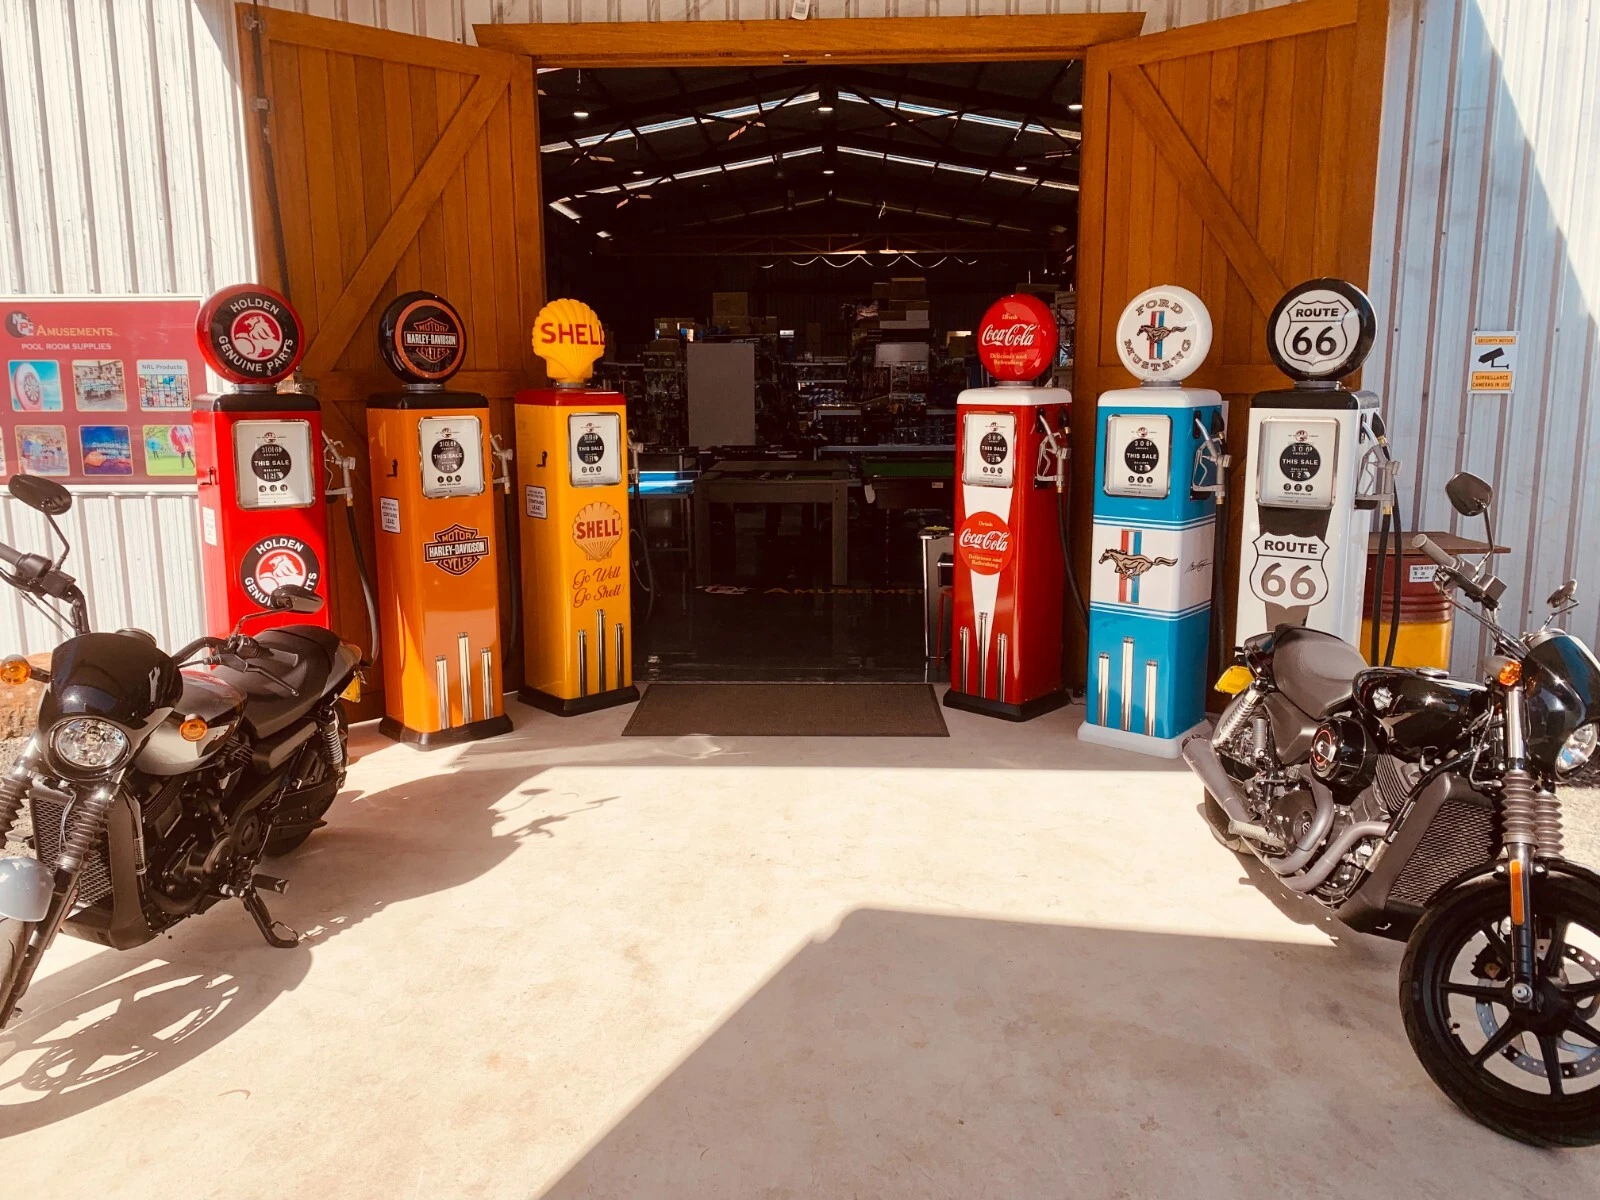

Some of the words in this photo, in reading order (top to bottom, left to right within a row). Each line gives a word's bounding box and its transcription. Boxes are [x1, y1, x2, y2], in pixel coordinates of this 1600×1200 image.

[230, 298, 280, 315] HOLDEN
[1135, 298, 1184, 317] FORD
[1295, 308, 1340, 318] ROUTE
[1002, 312, 1018, 320] Drink
[36, 325, 113, 337] AMUSEMENTS
[418, 321, 446, 332] MOTOR
[540, 322, 606, 346] SHELL
[981, 323, 1037, 346] Coca-Cola
[406, 333, 456, 345] HARLEY-DAVIDSON
[1292, 326, 1337, 356] 66
[219, 335, 263, 372] GENUINE
[266, 338, 293, 370] PARTS
[420, 347, 446, 360] CYCLES
[1124, 338, 1192, 372] MUSTANG
[441, 529, 471, 542] MOTOR
[576, 518, 620, 540] SHELL
[255, 537, 304, 555] HOLDEN
[959, 528, 1010, 552] Coca-Cola
[1264, 540, 1318, 554] ROUTE
[429, 541, 485, 558] HARLEY-DAVIDSON
[443, 556, 473, 571] CYCLES
[971, 560, 999, 569] Refreshing
[572, 569, 590, 590] Go
[592, 565, 621, 582] Well
[1260, 562, 1317, 600] 66
[244, 576, 273, 608] GENUI
[573, 587, 591, 608] Go
